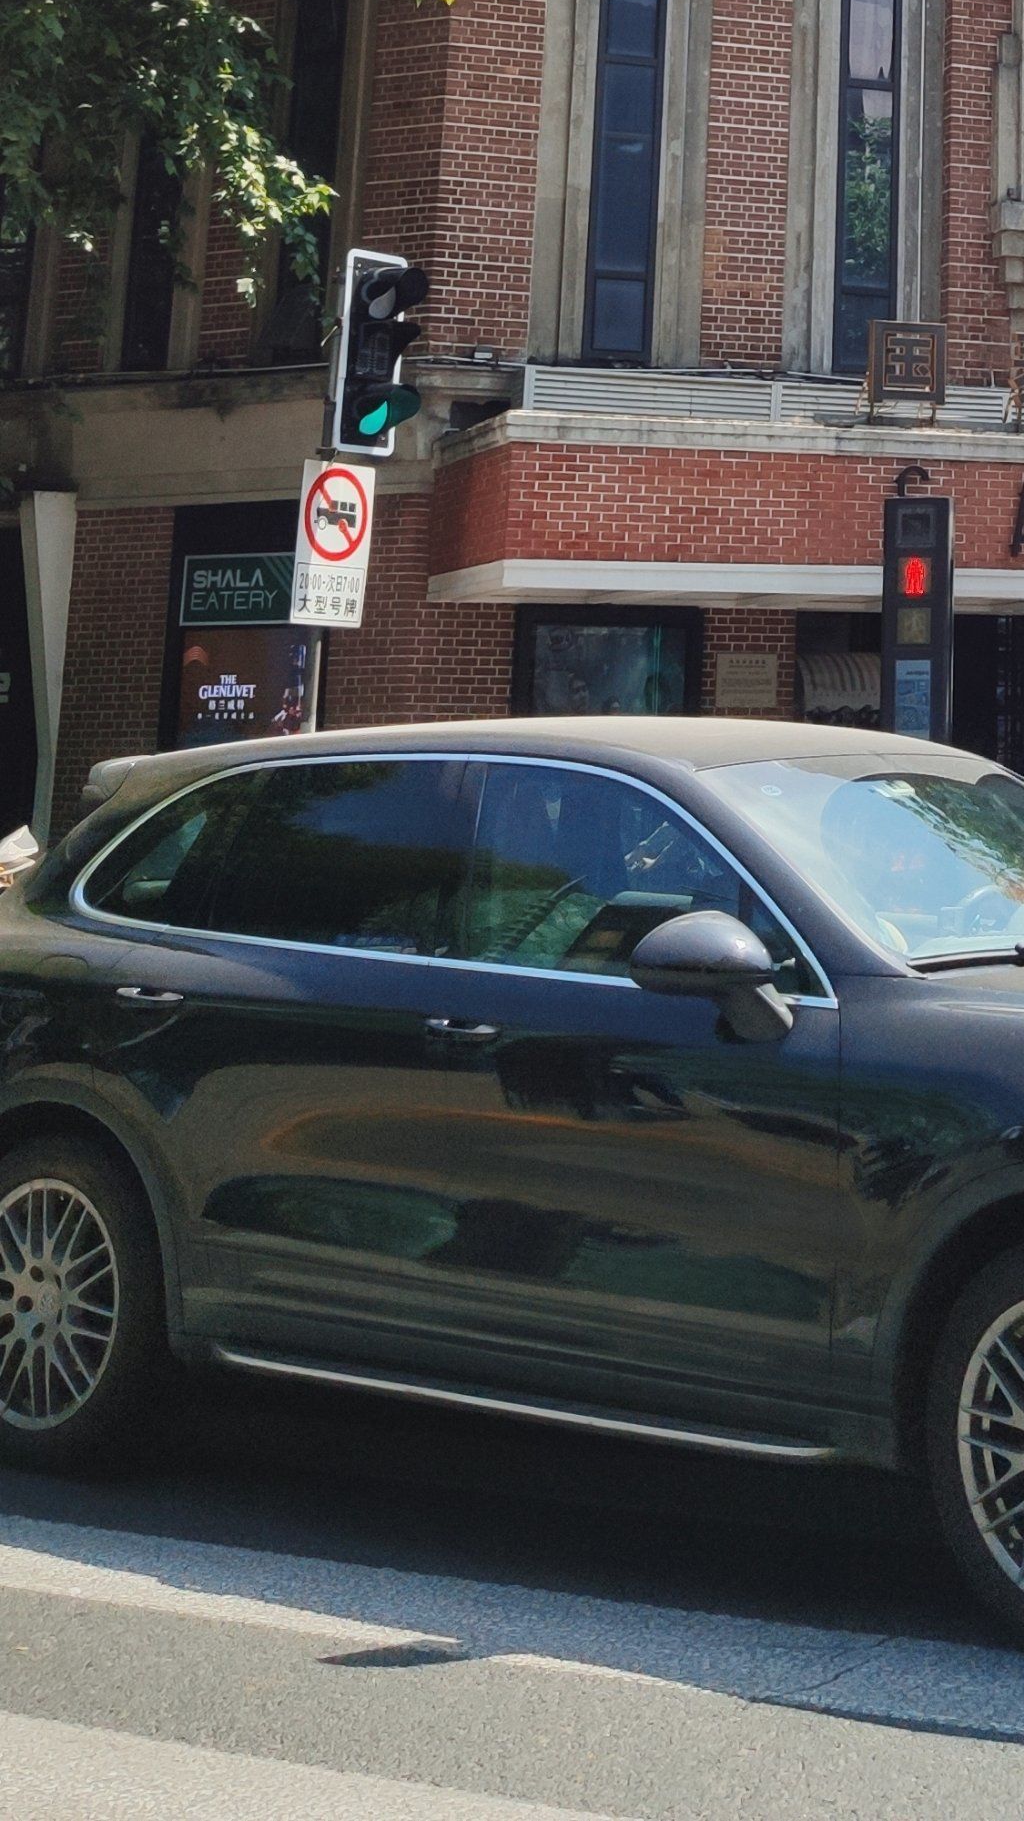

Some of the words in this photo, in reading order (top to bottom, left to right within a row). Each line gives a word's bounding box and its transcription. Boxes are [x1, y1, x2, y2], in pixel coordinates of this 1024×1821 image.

[193, 568, 264, 589] SHALA
[190, 589, 278, 611] EATERY
[298, 593, 358, 617] 大型号牌
[219, 674, 237, 684] THE
[198, 684, 257, 700] GLENLIVET
